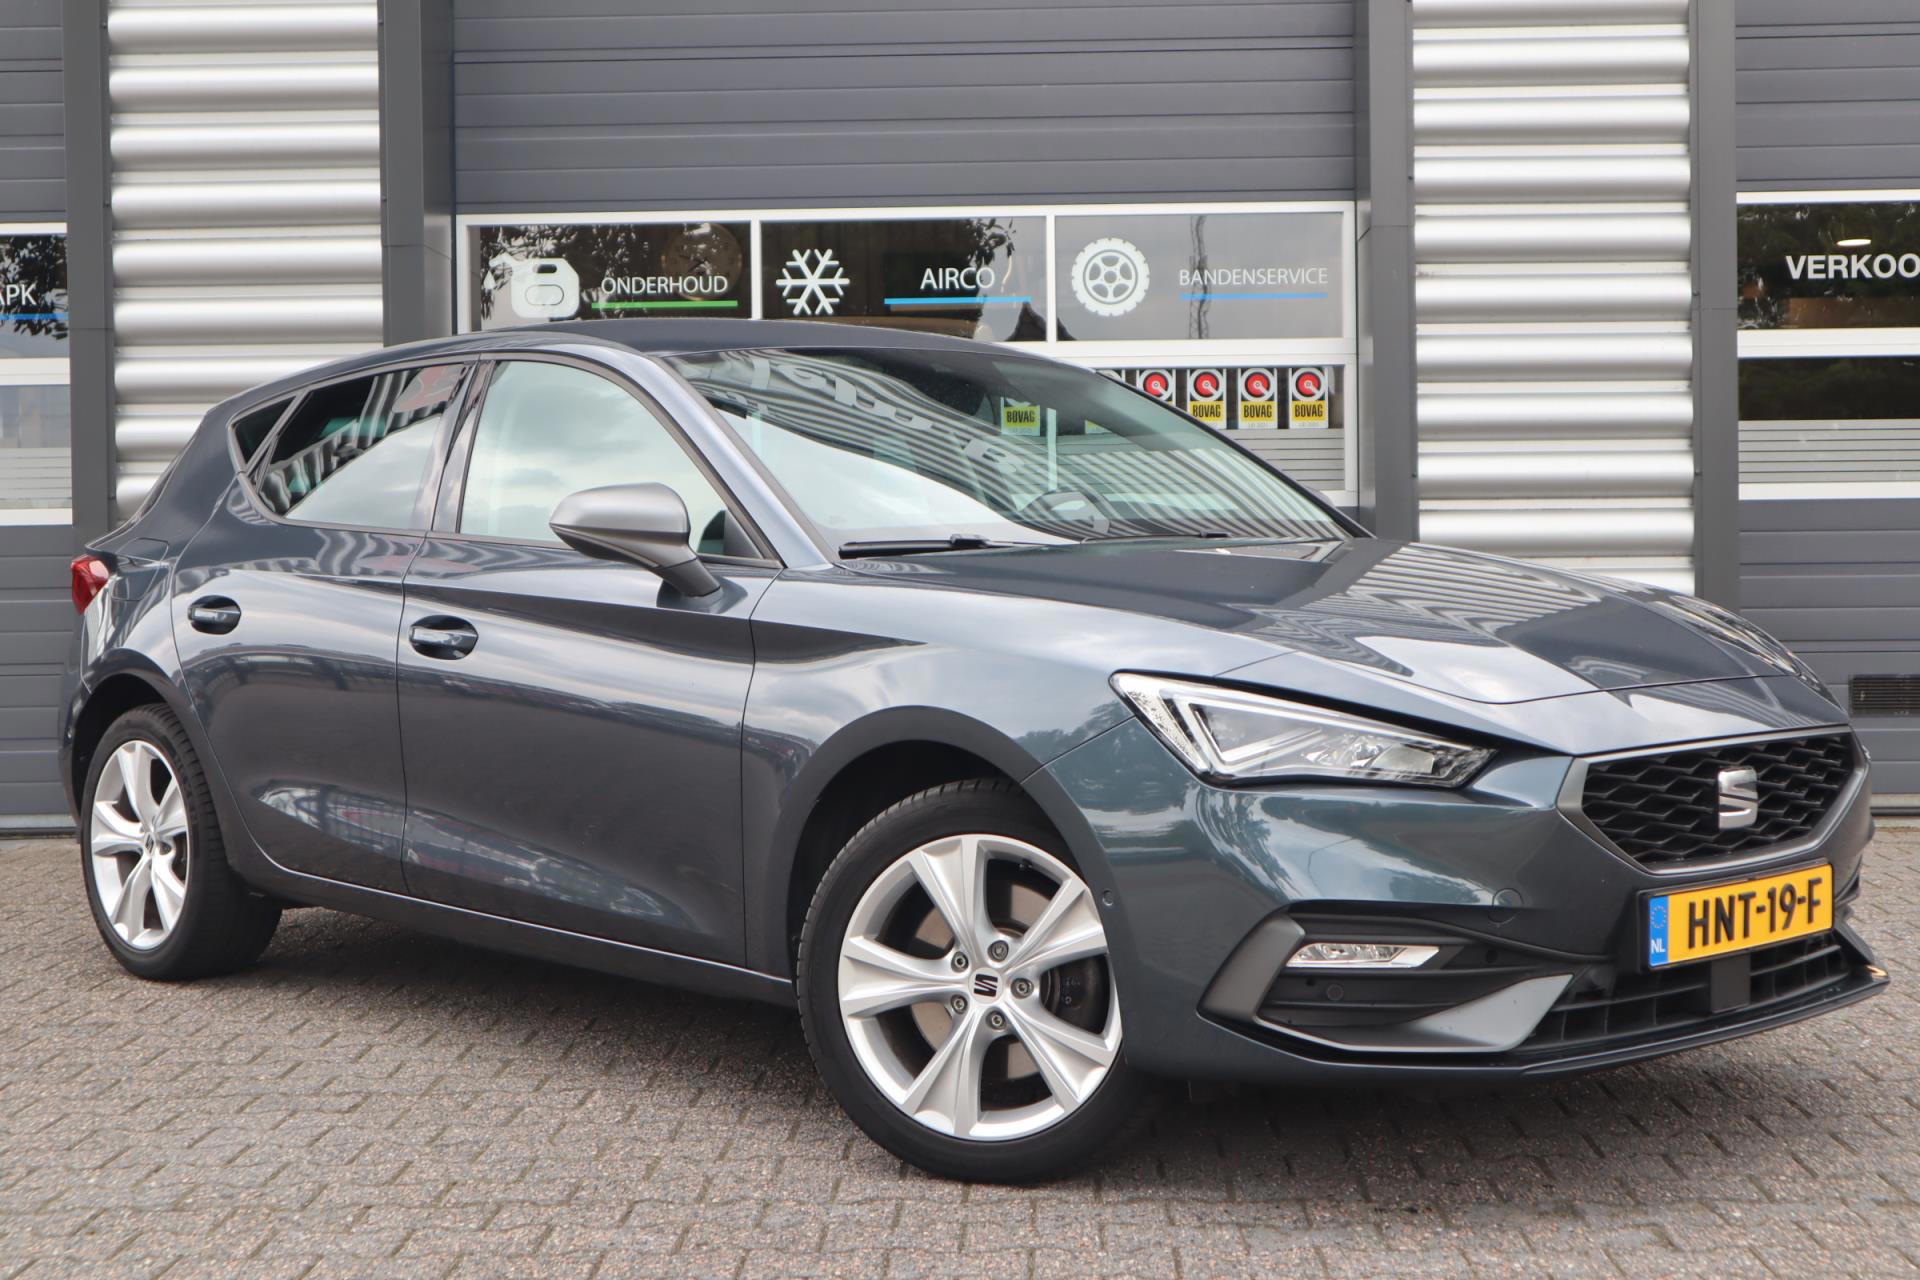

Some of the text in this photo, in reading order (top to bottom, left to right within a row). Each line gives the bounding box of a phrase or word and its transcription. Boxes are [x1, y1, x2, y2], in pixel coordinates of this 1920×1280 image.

[1785, 253, 1920, 279] VERKOO
[601, 275, 728, 294] ONDERHOUD
[920, 267, 995, 289] AIRCO
[1179, 268, 1328, 285] BANDENSERVICE
[1007, 410, 1035, 423] BOVAG
[1193, 404, 1221, 418] BOVAG
[1243, 404, 1273, 418] BOVAG
[1294, 403, 1323, 418] BOVAG
[1687, 877, 1823, 949] HNT-19-F
[1651, 938, 1666, 954] NL
